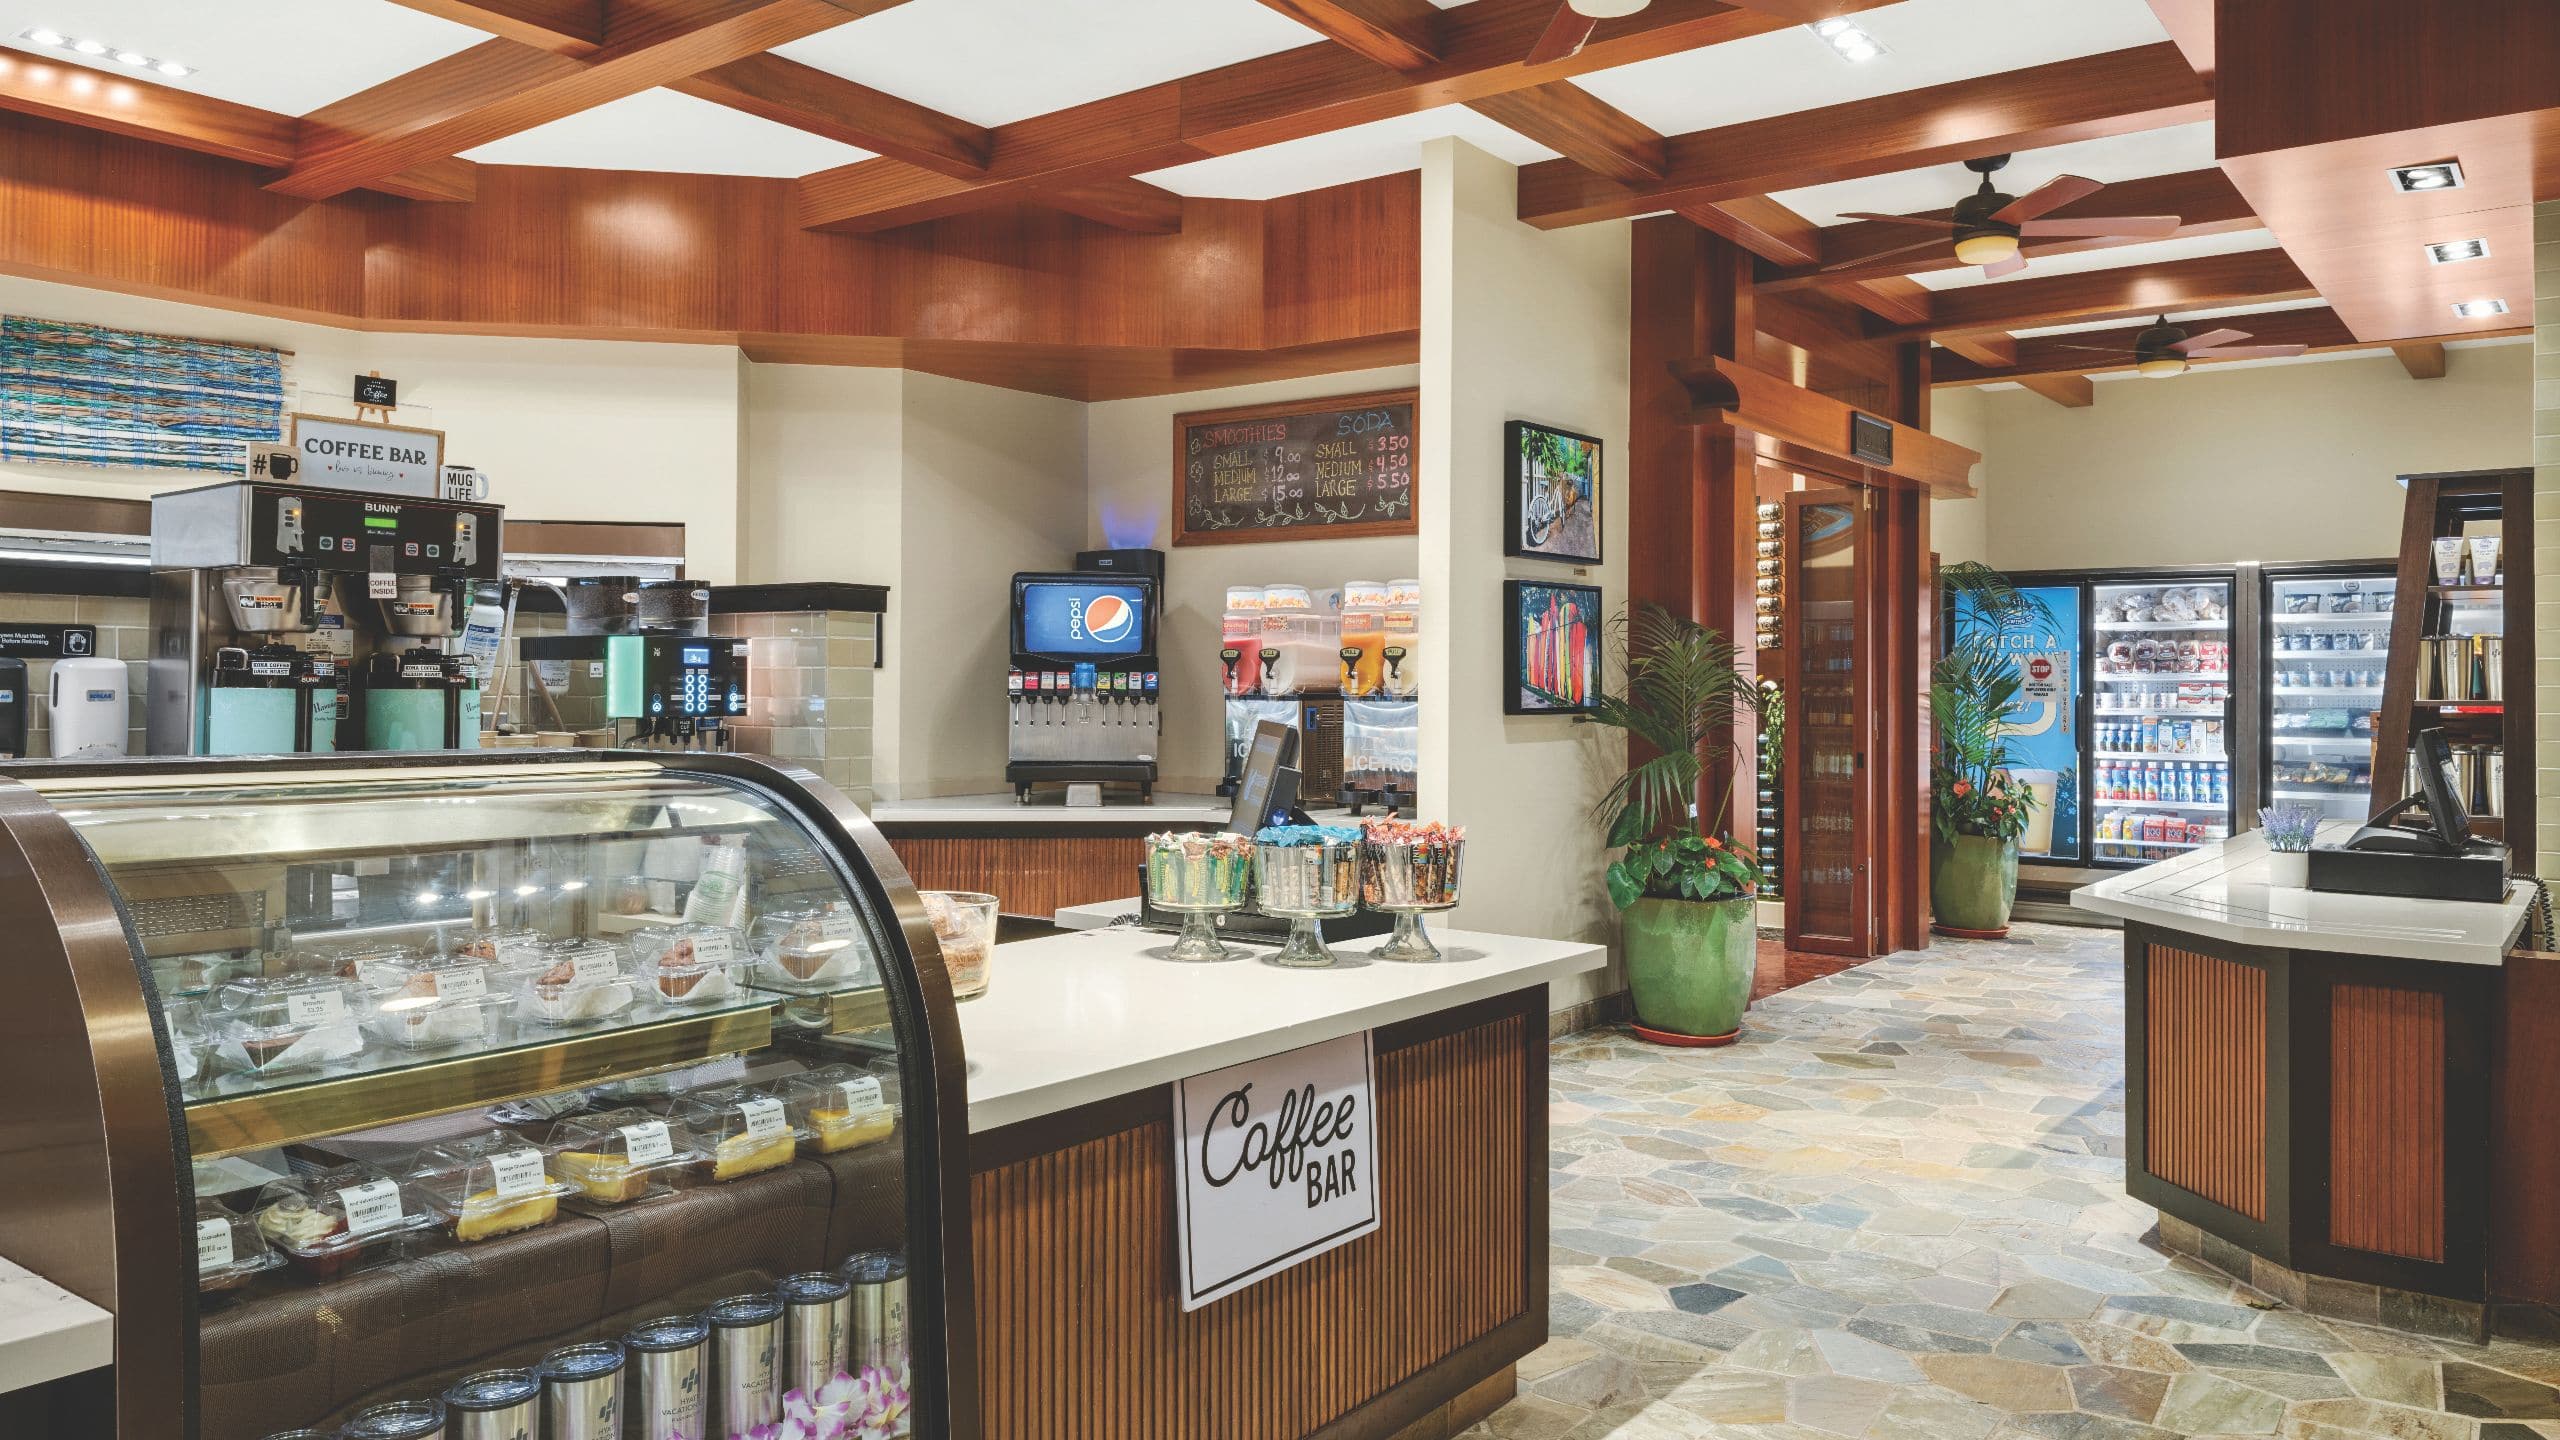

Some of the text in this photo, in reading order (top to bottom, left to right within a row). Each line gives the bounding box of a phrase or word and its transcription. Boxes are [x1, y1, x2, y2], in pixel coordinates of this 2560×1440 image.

[1336, 411, 1395, 437] SODA
[1202, 423, 1287, 449] SMOOTHIES
[304, 438, 427, 466] COFFEE BAR
[1213, 450, 1253, 470] SMALL
[1315, 441, 1357, 459] SMALL
[447, 472, 474, 487] MUG
[1213, 468, 1257, 488] MEDIUM
[1316, 459, 1362, 481] MEDIUM
[448, 487, 473, 501] LIFE
[1214, 485, 1253, 504] LARGE
[1315, 478, 1357, 499] LARGE
[364, 502, 400, 515] BUNN
[369, 579, 397, 588] COFFEE
[371, 588, 395, 596] INSIDE
[1068, 597, 1084, 640] pepsi
[2045, 634, 2057, 649] A
[2031, 665, 2051, 674] STOP
[1201, 1082, 1355, 1190] Coffee
[1306, 1148, 1356, 1209] BAR
